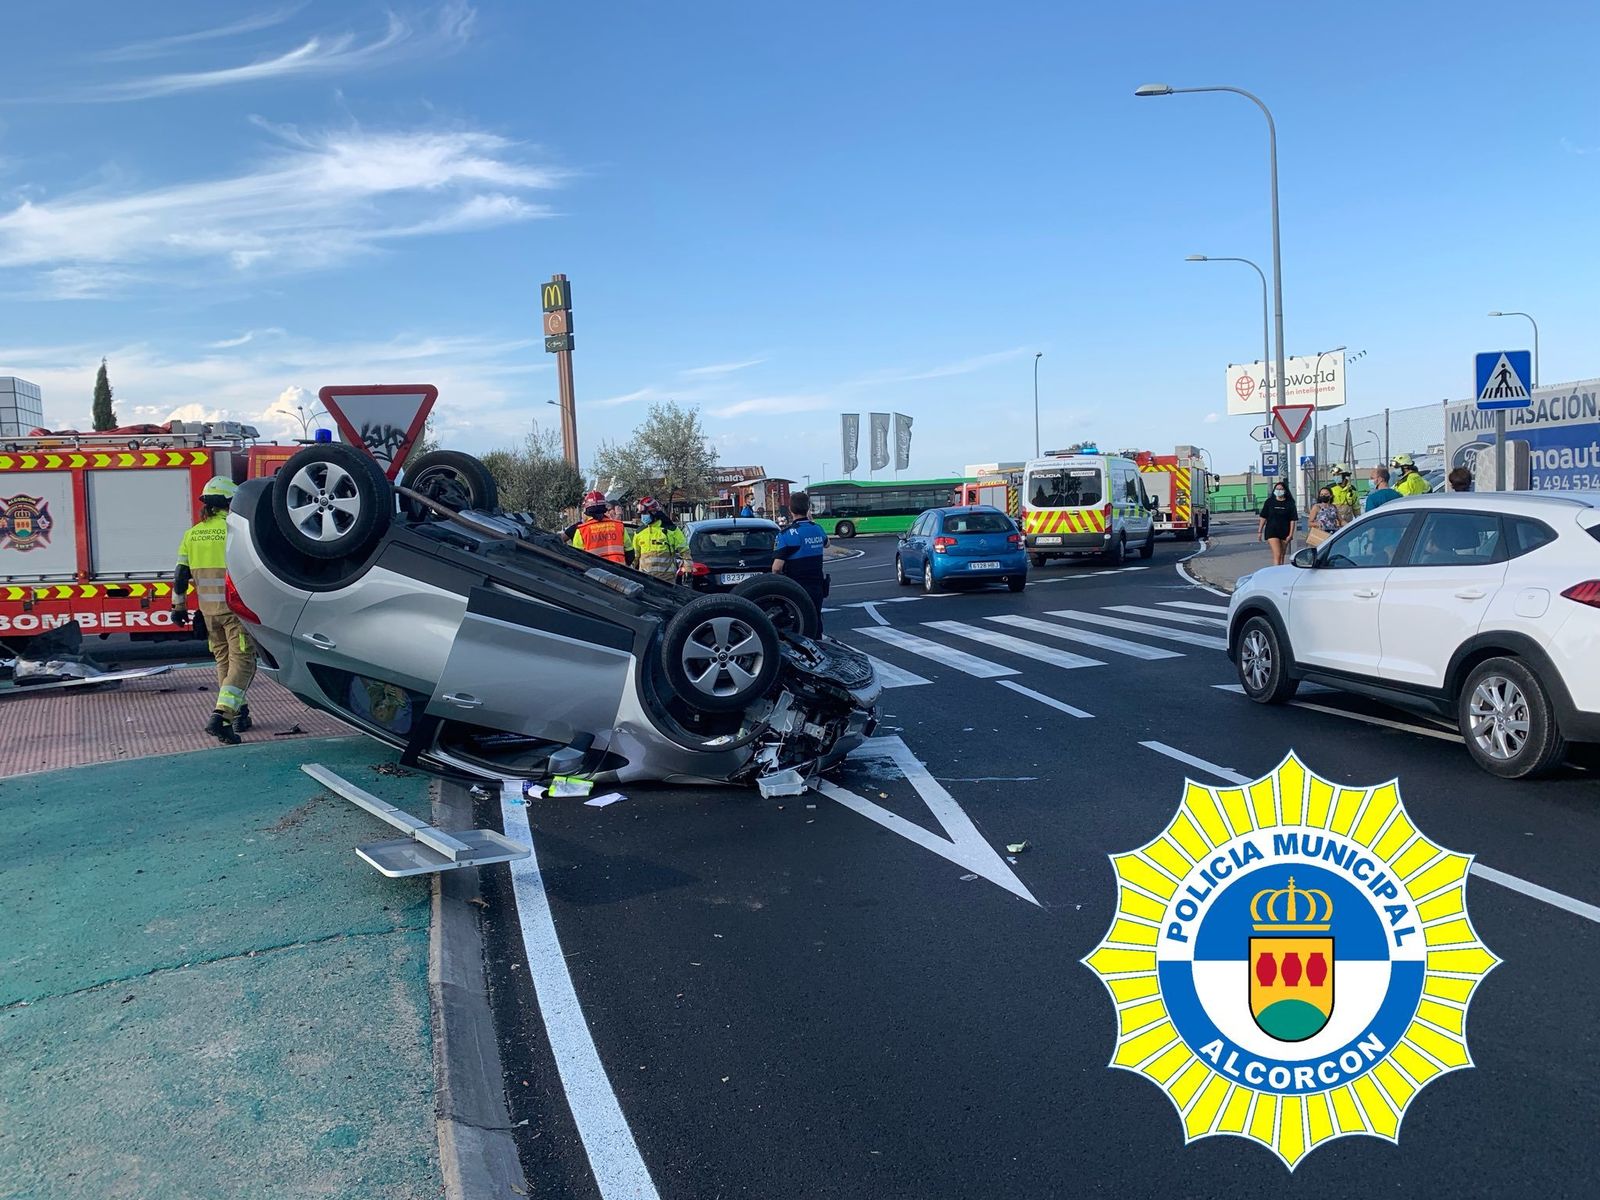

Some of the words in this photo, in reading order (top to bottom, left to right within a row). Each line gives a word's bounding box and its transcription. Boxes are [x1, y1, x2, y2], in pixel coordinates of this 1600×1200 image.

[1259, 370, 1335, 390] AuoWorld
[1450, 405, 1496, 433] MÁXIM
[726, 574, 746, 582] 8237
